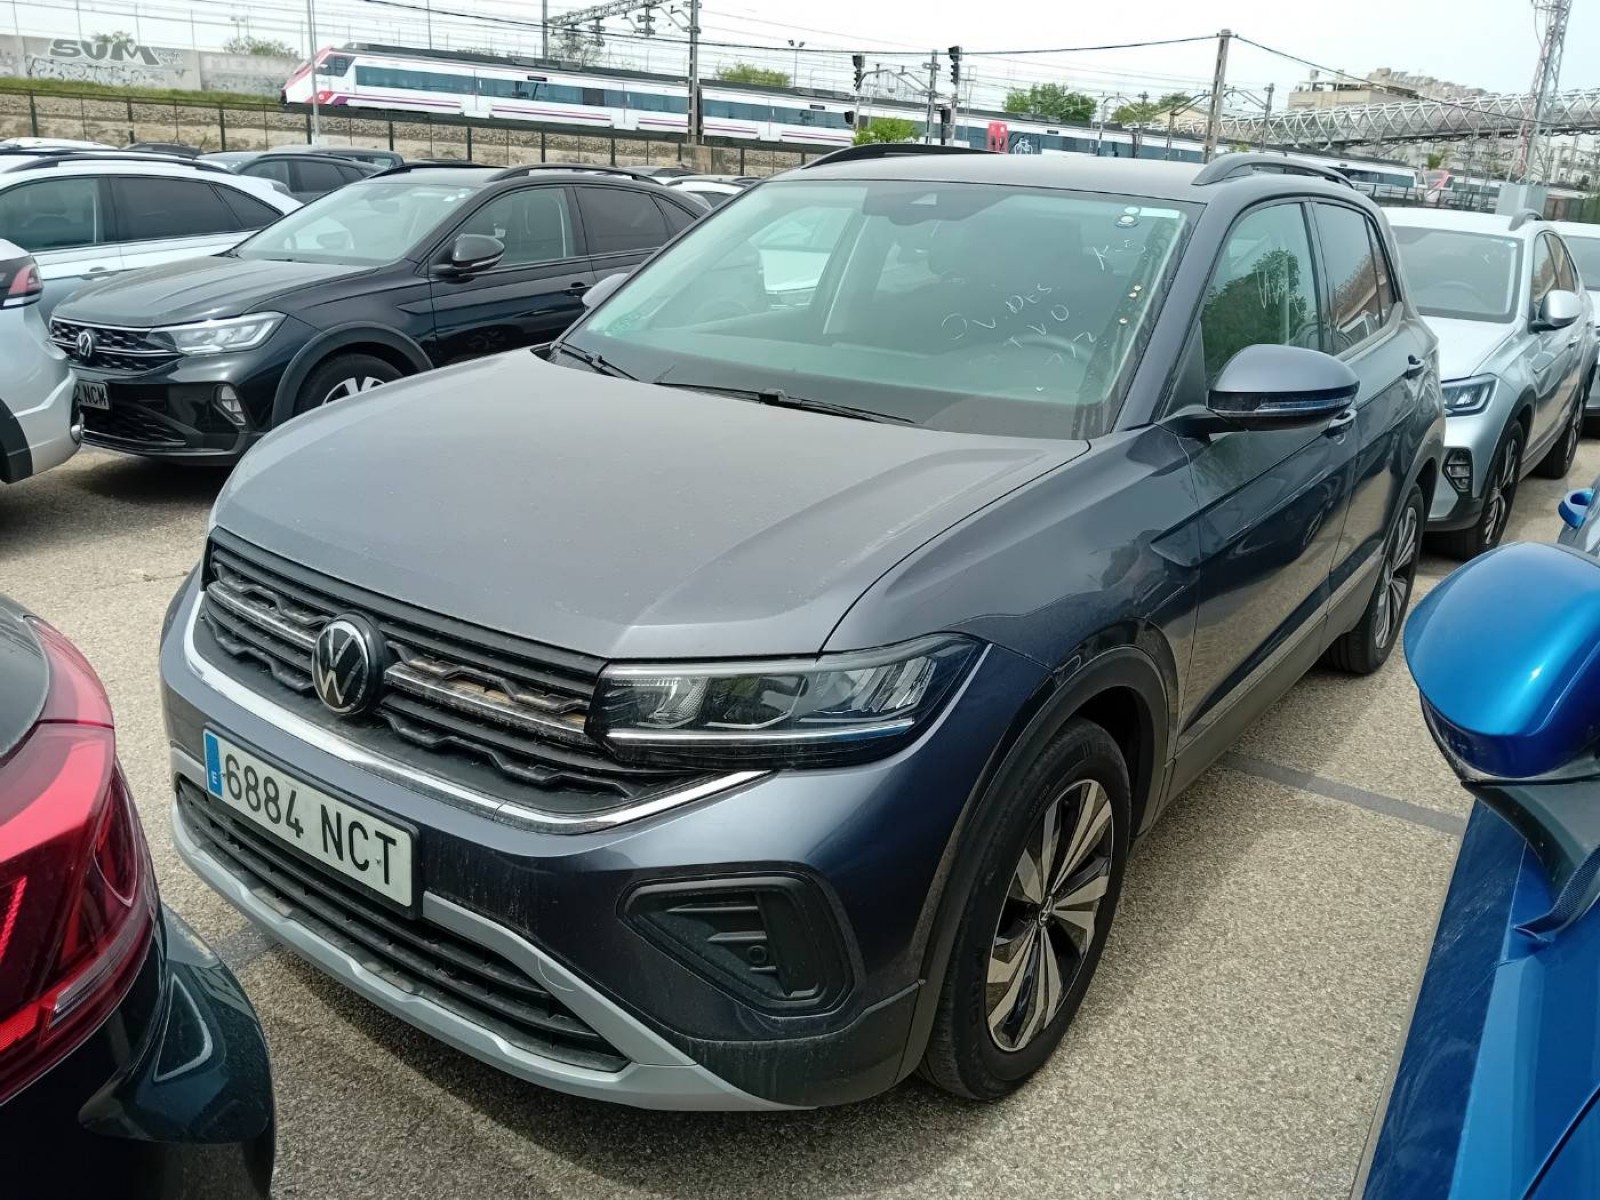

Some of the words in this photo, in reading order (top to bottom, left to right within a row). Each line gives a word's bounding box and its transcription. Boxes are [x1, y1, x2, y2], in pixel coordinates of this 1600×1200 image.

[83, 383, 107, 407] NCM
[211, 771, 218, 785] E
[225, 753, 304, 839] 6884
[320, 803, 397, 885] NCT
